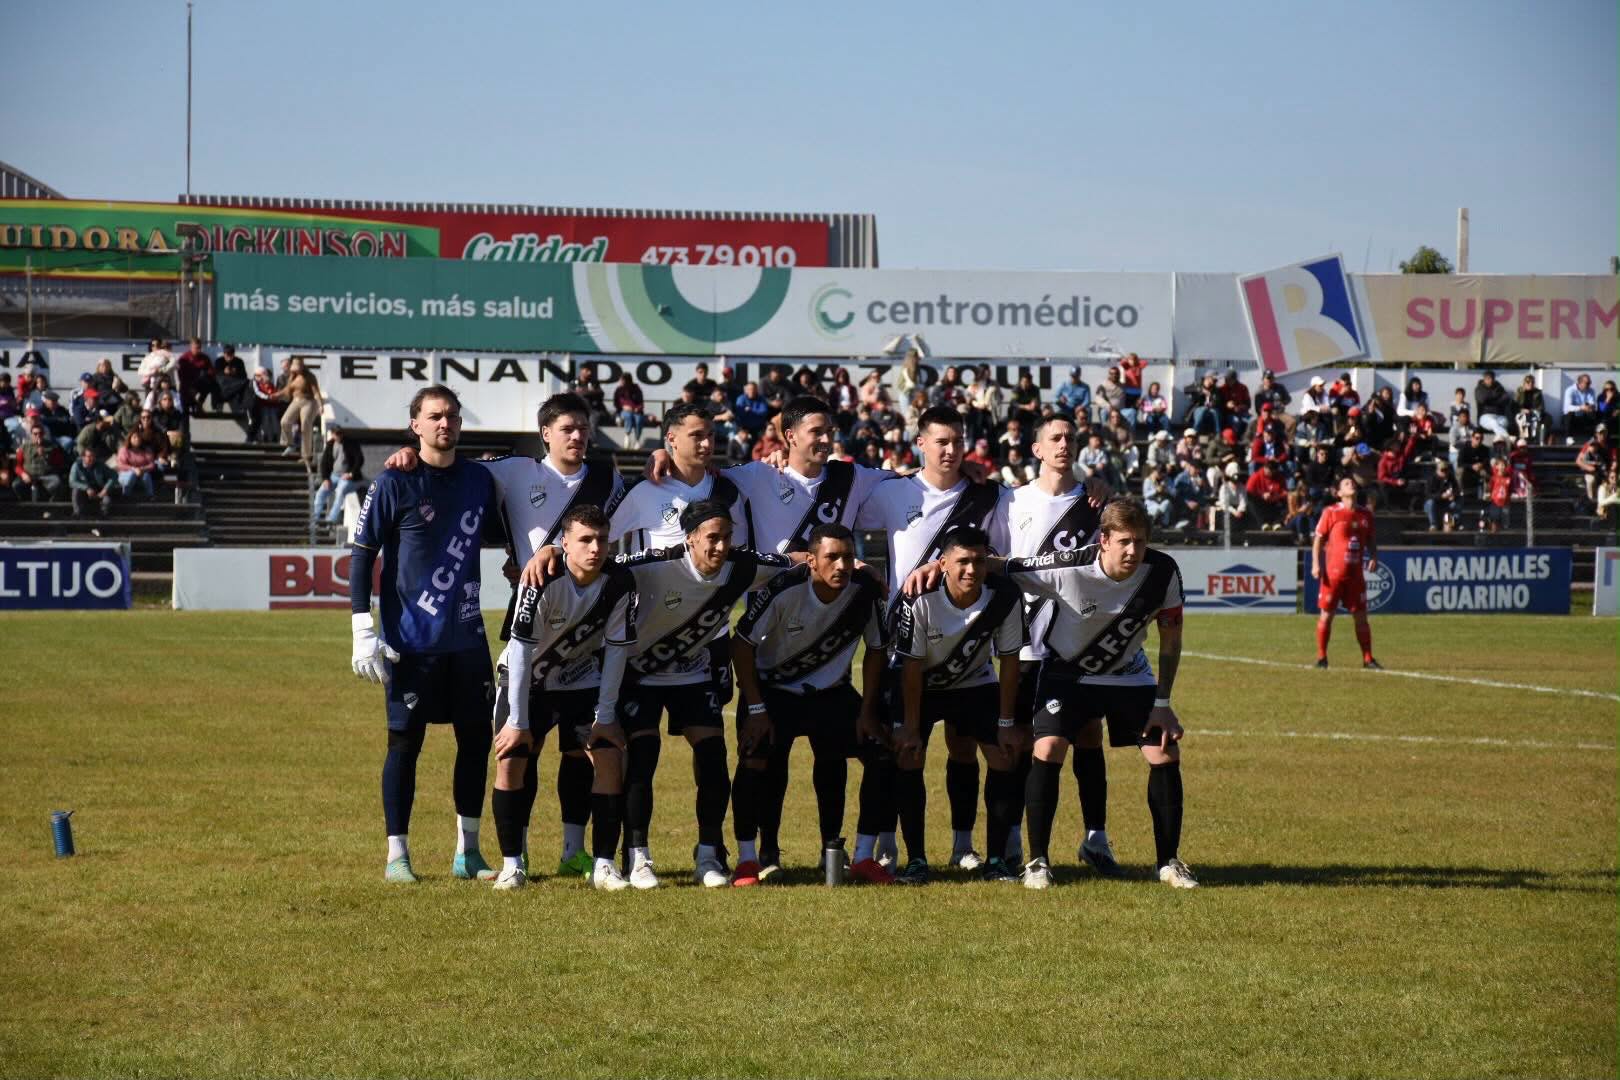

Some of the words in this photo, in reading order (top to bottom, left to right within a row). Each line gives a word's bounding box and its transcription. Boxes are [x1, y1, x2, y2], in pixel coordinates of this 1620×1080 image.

[176, 222, 408, 260] DICKINSON
[462, 232, 609, 263] Calidad
[640, 245, 689, 266] 473
[223, 287, 280, 312] más
[287, 292, 414, 319] servicios,
[422, 295, 475, 318] más
[483, 296, 553, 319] salud
[867, 293, 1139, 329] centromédico
[1406, 297, 1620, 340] SUPERM
[291, 355, 673, 386] FERNANDO
[354, 494, 373, 536] antel
[0, 560, 122, 598] LTIJO
[1406, 554, 1551, 582] NARANJALES
[1207, 575, 1276, 596] FENIX
[1426, 584, 1530, 610] GUARINO
